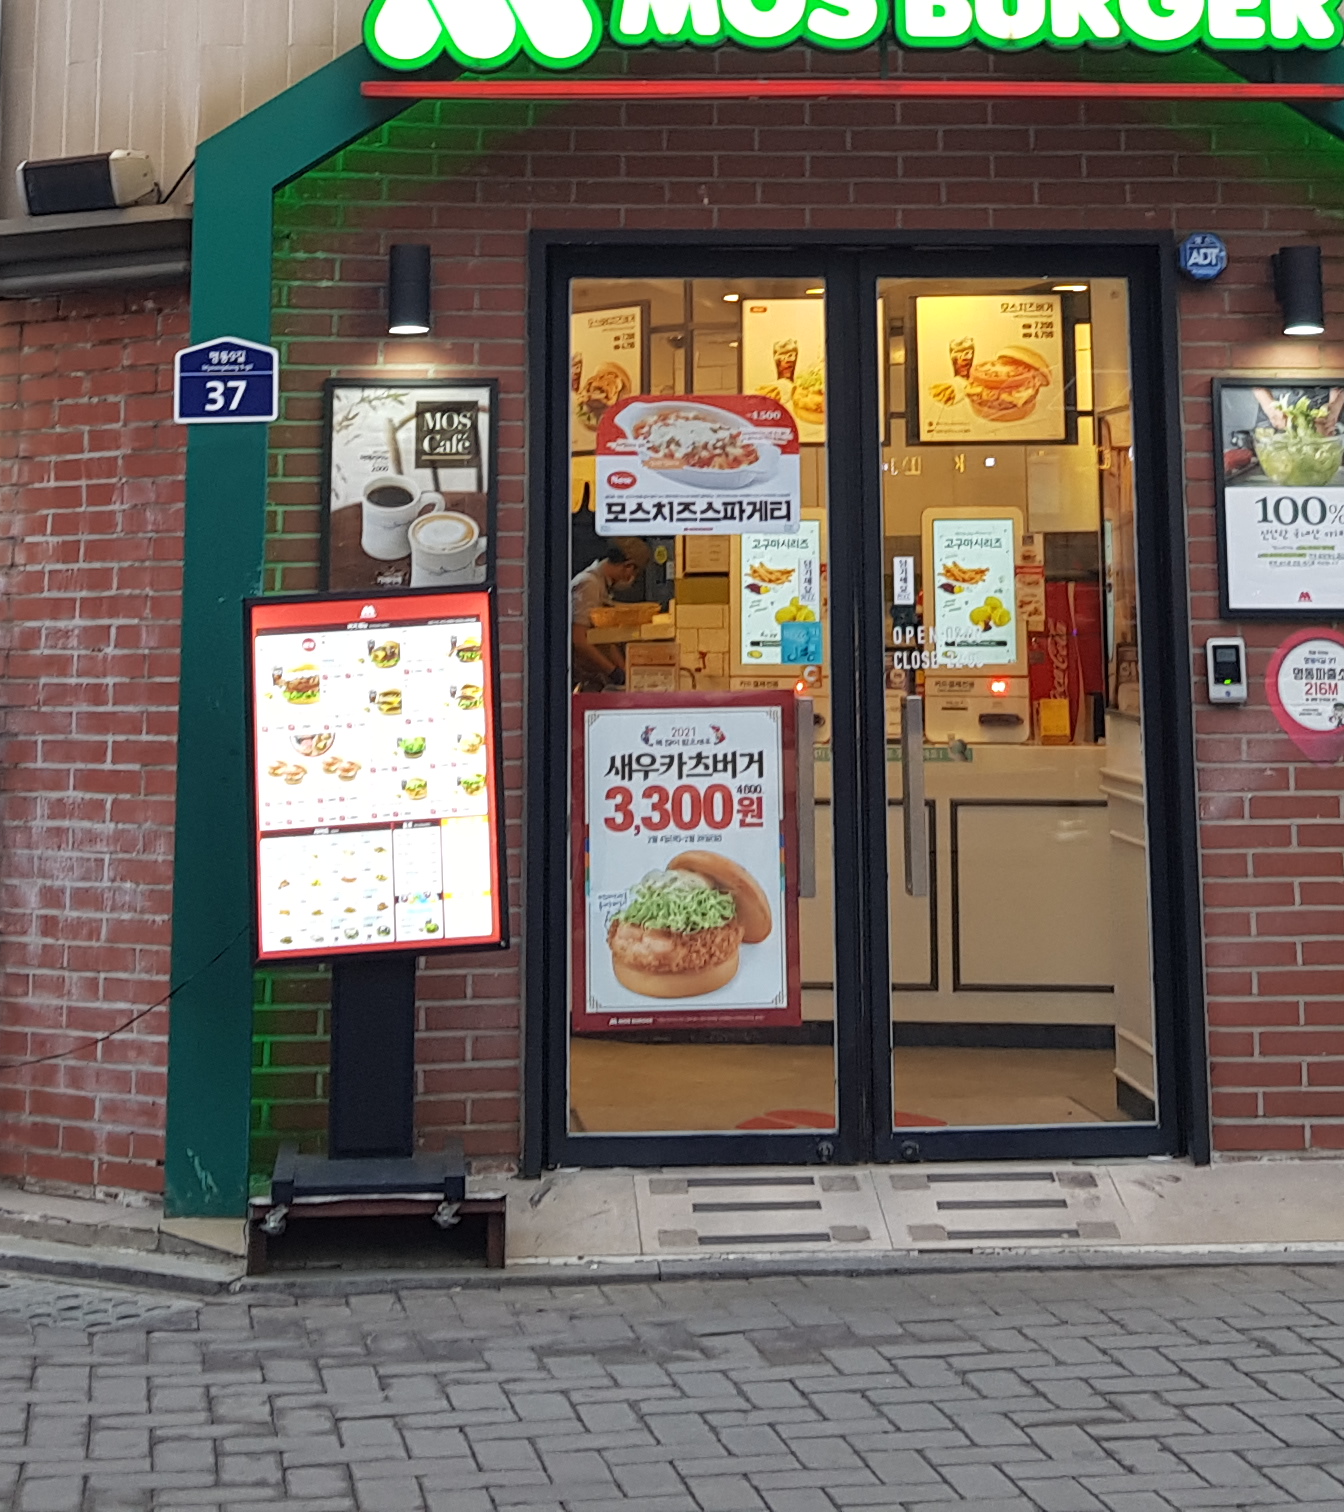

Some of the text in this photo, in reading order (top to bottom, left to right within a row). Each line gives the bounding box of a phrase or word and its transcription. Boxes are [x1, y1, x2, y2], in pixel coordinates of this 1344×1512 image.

[1187, 249, 1219, 267] ADT
[204, 380, 248, 411] 37
[422, 411, 472, 430] MOS
[422, 433, 471, 455] Café
[609, 475, 634, 486] New
[605, 500, 791, 522] 모스치즈스파게티
[752, 539, 809, 550] 고구마시리즈
[944, 538, 1003, 549] 고구마시리즈
[1304, 682, 1339, 696] 216M
[671, 726, 697, 737] 2021
[605, 750, 764, 781] 새우카츠버거
